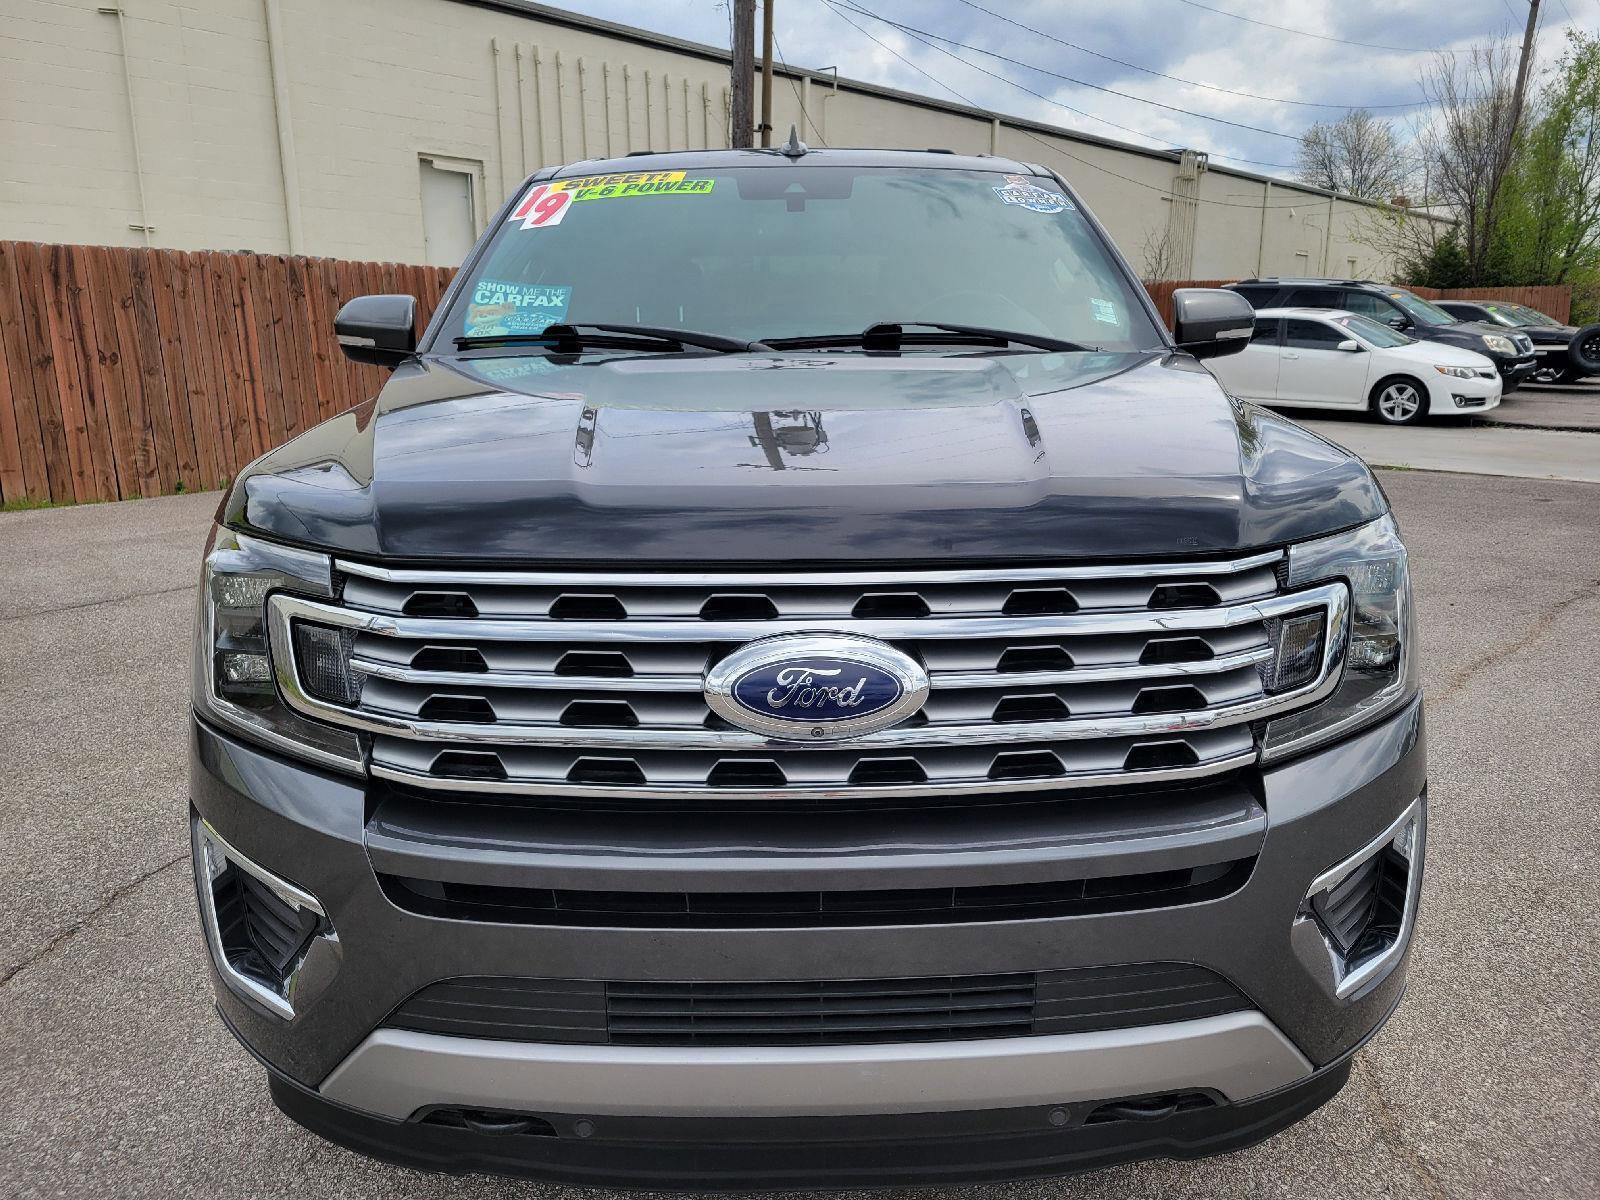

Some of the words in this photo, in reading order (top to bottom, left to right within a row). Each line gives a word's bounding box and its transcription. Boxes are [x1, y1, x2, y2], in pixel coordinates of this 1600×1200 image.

[562, 172, 670, 190] SWEET!
[574, 188, 615, 200] V-6
[621, 180, 709, 194] POWER
[515, 186, 570, 226] 19
[474, 290, 564, 307] CARFAX
[477, 281, 520, 294] SHOW
[522, 287, 541, 296] ME
[544, 288, 567, 297] THE
[766, 667, 866, 708] Ford
